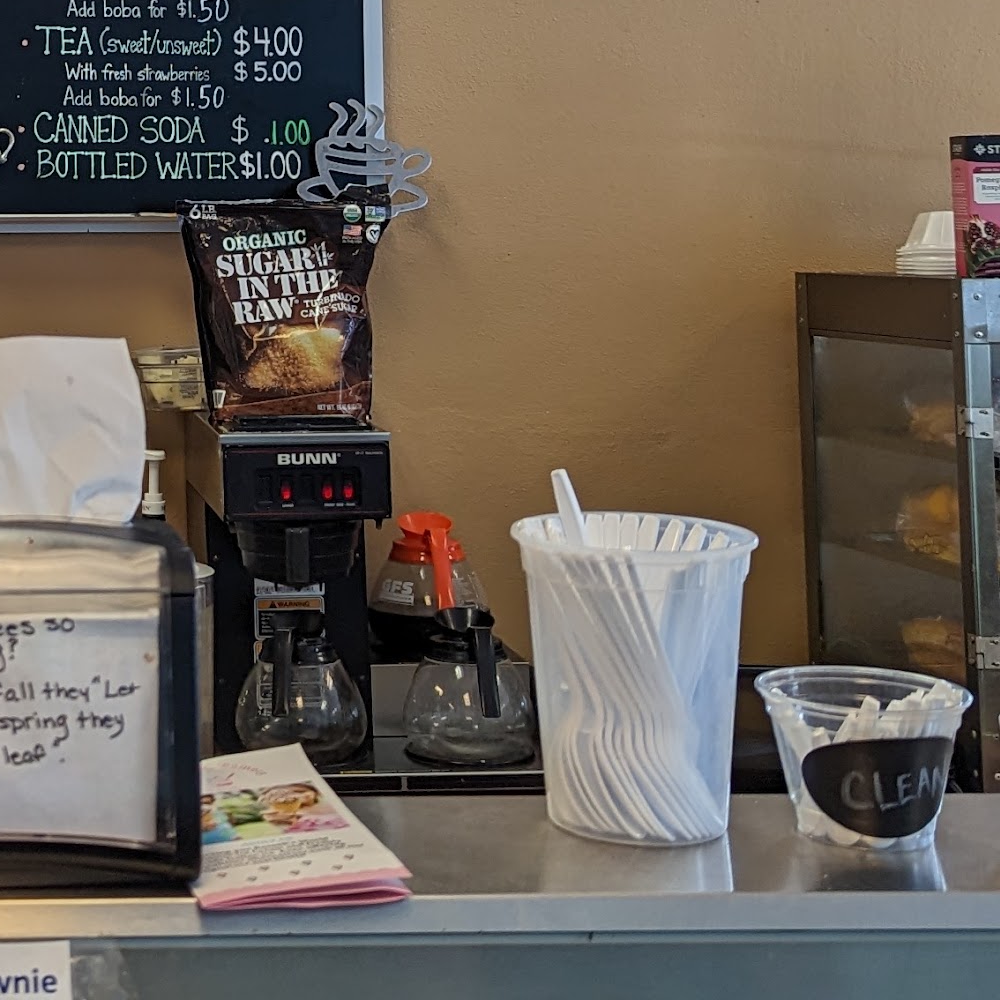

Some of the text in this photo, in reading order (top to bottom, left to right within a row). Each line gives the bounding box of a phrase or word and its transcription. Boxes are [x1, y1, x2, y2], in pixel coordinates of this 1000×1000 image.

[34, 24, 303, 57] TEA (sweet/unsweet) $4.00
[64, 60, 302, 83] With fresh strawberries $5.00
[62, 84, 225, 109] Add boba $1.50
[33, 111, 206, 145] CANNED SODA
[36, 149, 302, 180] BOTTLED WATER $1.00
[222, 229, 307, 252] ORGANIC
[215, 247, 315, 278] SUGAR
[237, 268, 340, 300] IN THE
[303, 292, 361, 309] TURBINADO
[277, 452, 337, 465] BUNN
[77, 710, 126, 739] they
[841, 767, 944, 812] CLEAN
